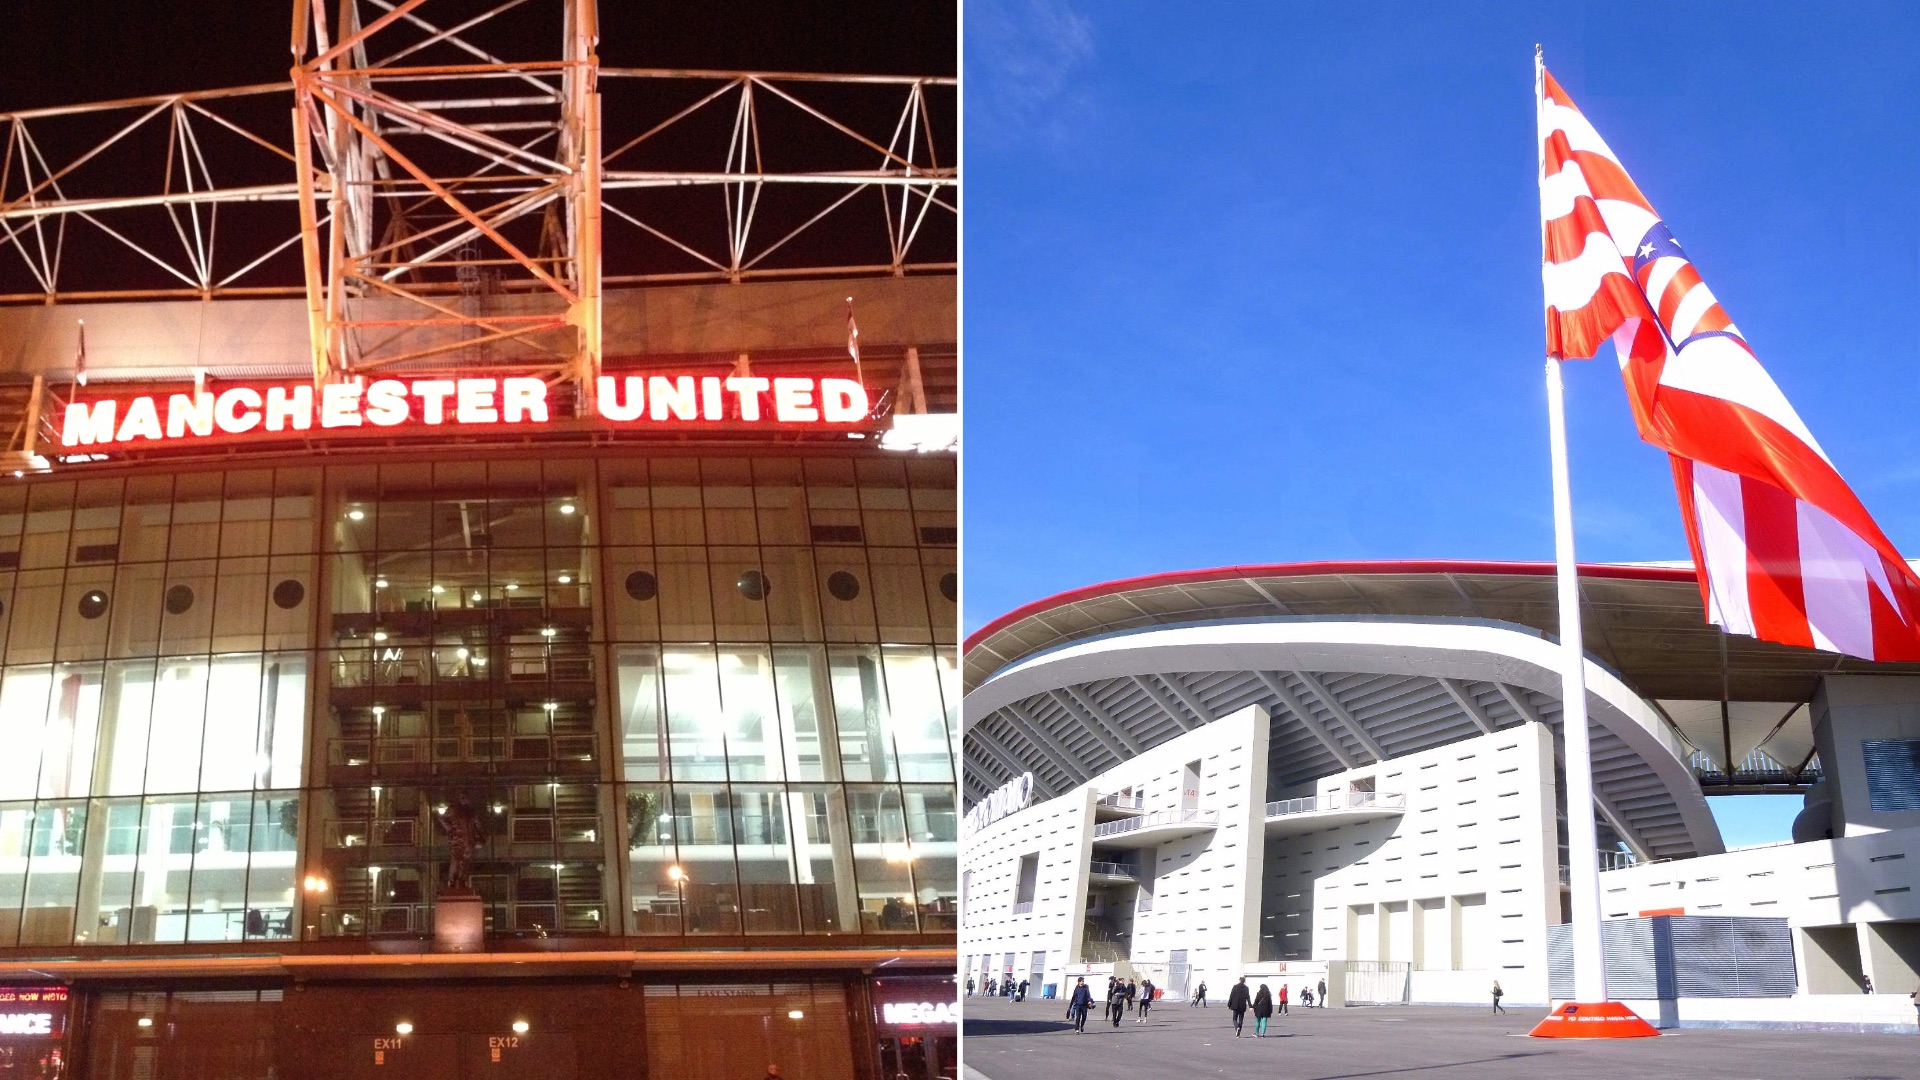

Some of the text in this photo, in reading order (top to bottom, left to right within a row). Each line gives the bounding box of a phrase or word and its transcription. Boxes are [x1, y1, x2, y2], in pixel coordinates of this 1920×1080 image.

[61, 375, 869, 447] MANCHESTER UNITED
[374, 1038, 402, 1049] EX11
[489, 1037, 519, 1048] EX12
